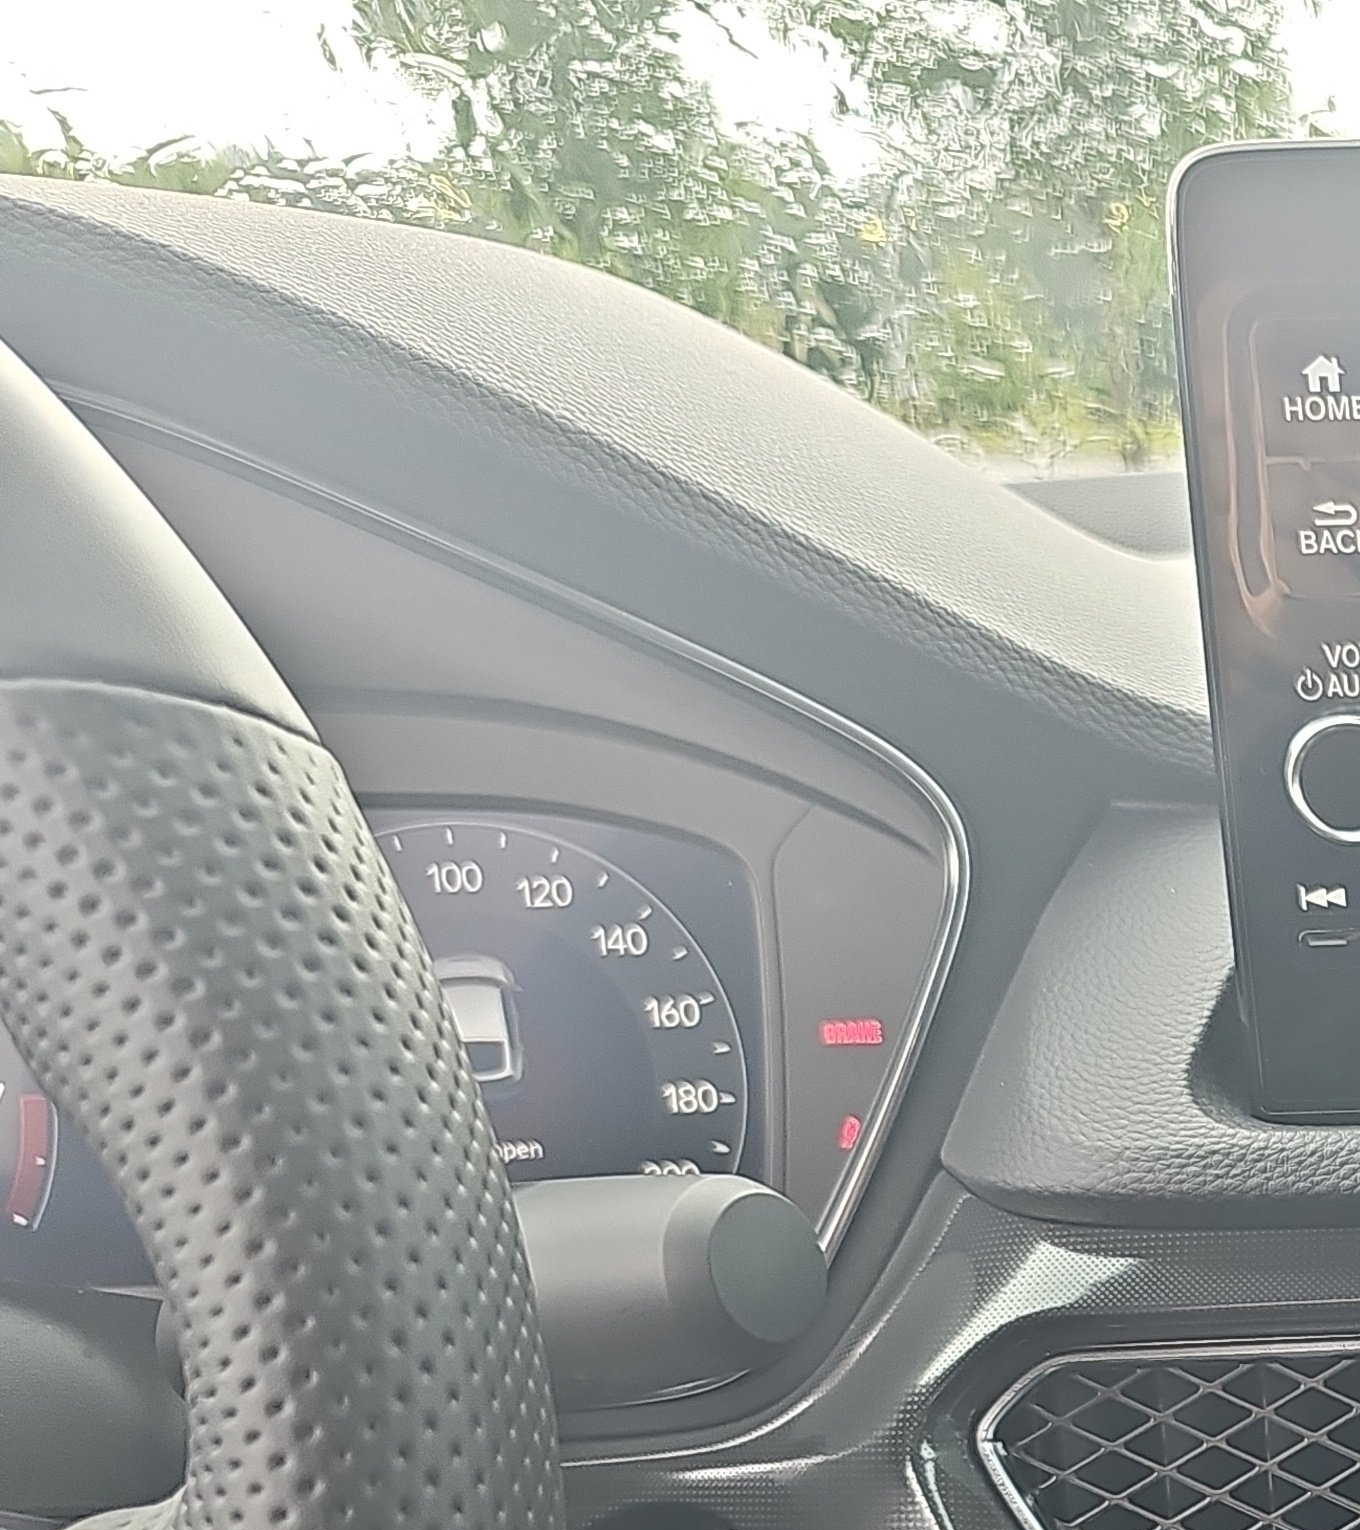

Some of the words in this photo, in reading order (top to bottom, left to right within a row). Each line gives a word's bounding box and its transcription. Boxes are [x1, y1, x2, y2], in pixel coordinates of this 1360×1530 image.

[426, 862, 483, 894] 100
[517, 876, 574, 909] 120
[594, 925, 648, 956] 140
[645, 997, 702, 1029] 160
[663, 1083, 719, 1113] 180
